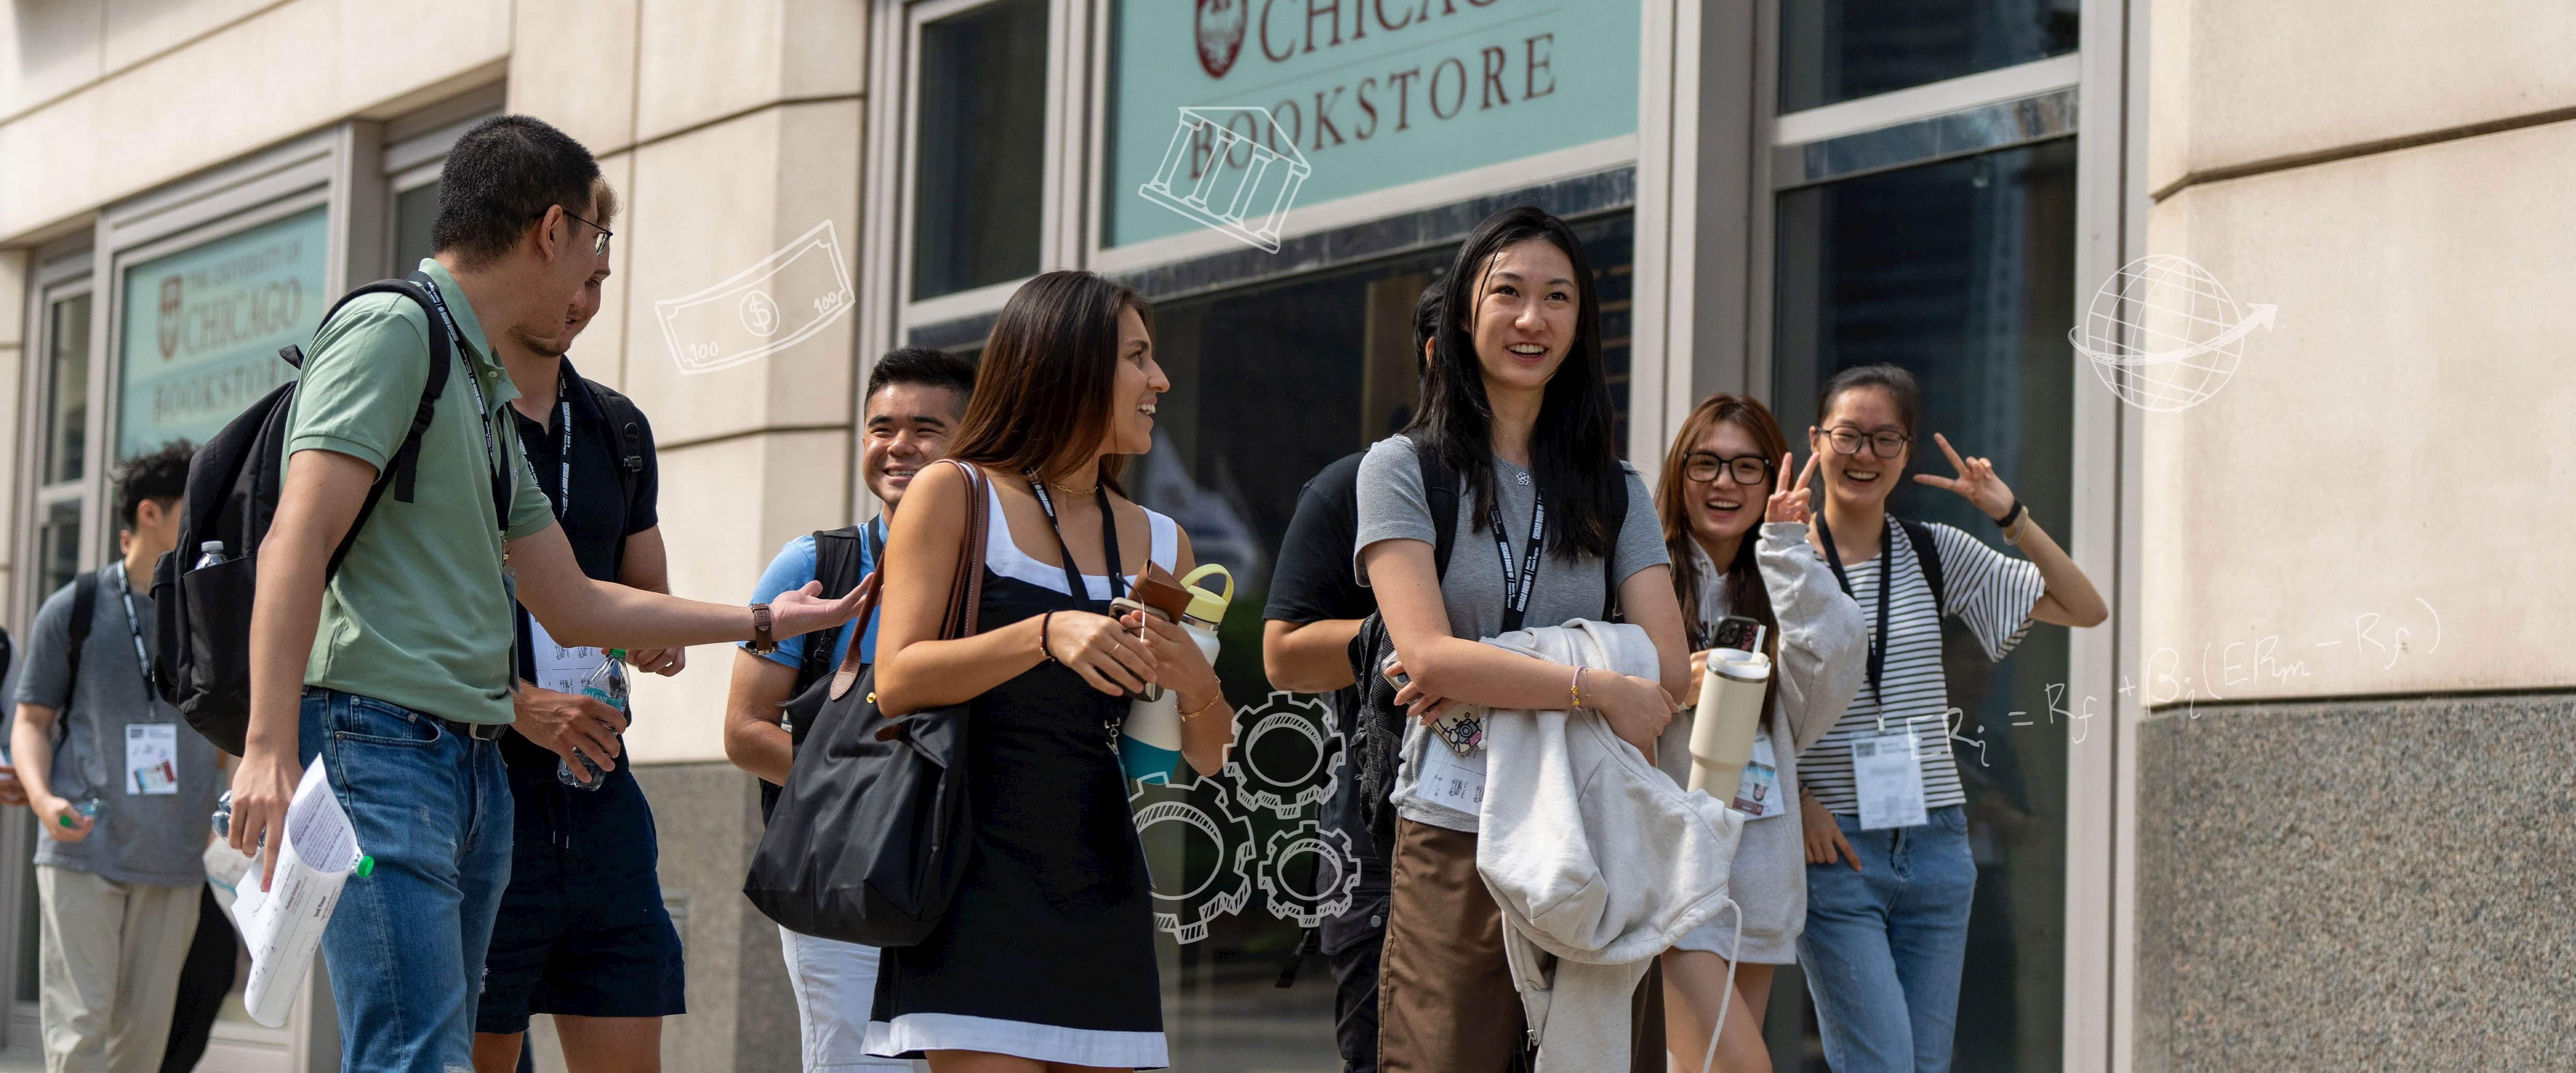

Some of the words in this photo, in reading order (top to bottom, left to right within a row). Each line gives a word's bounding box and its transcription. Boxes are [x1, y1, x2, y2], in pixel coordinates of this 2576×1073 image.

[1189, 32, 1557, 180] BOOKSTORE
[181, 275, 302, 355] CHICAGO
[440, 311, 451, 326] BOOTH
[447, 324, 459, 342] CHICAGO
[476, 398, 485, 415] CHICAGO
[1535, 509, 1545, 524] BOOTH
[1532, 522, 1543, 540] CHICAGO
[1500, 542, 1511, 559] CHICAGO
[1504, 558, 1514, 572] BOOTH
[1516, 594, 1528, 612] CHICAGO
[1522, 581, 1531, 597] BOOTH
